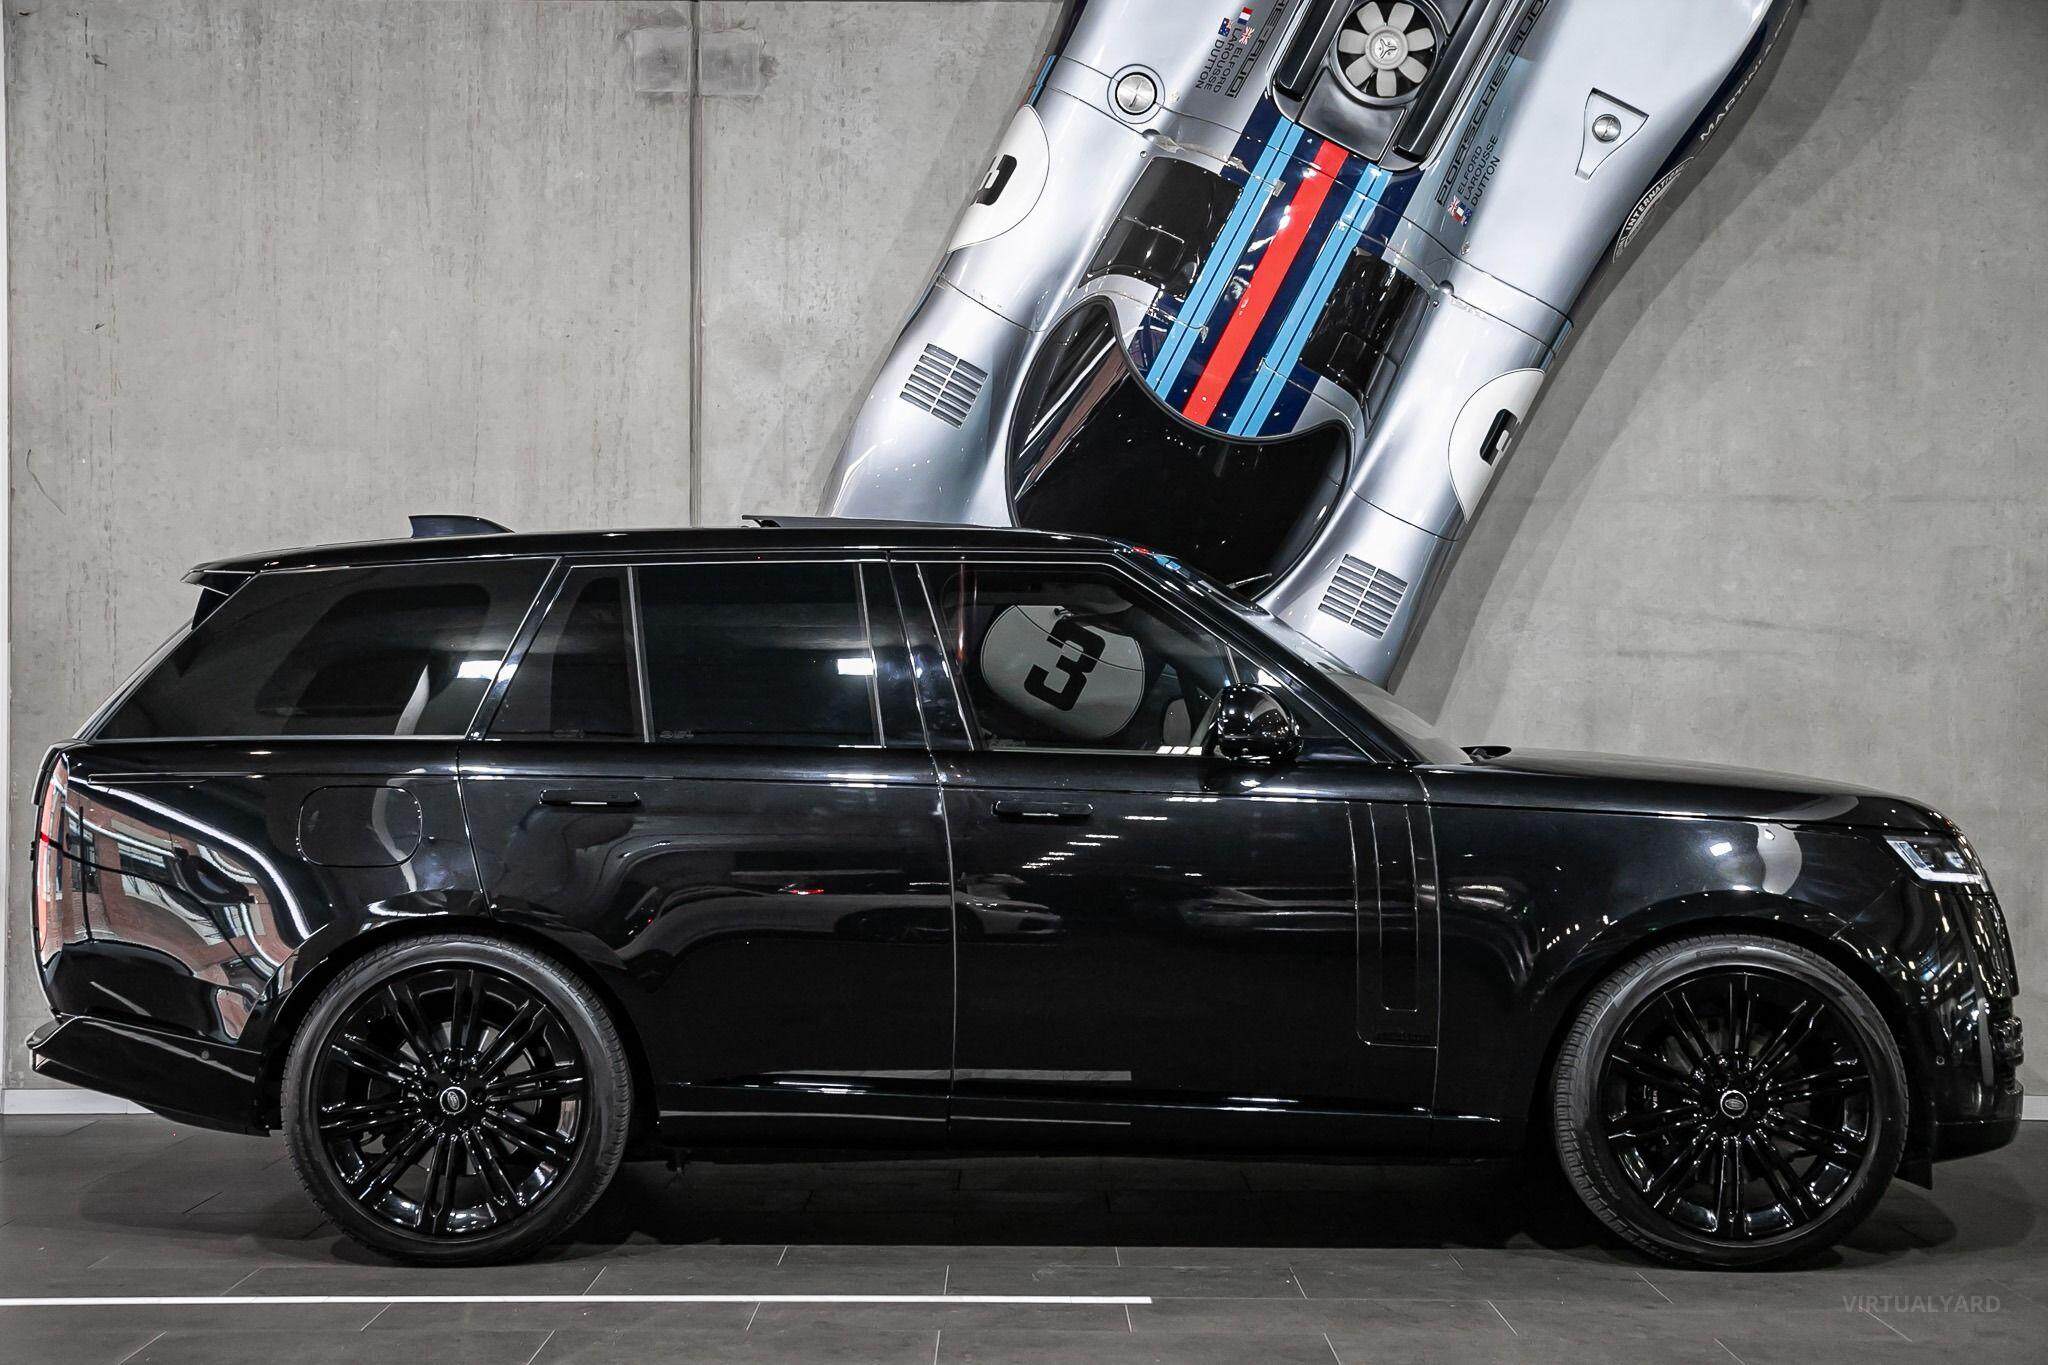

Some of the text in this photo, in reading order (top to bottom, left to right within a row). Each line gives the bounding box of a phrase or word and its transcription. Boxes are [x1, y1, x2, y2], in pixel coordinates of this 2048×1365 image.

[1195, 39, 1225, 89] DUTTON
[1203, 27, 1242, 91] LAROUSSE
[1213, 47, 1243, 93] ELFORD
[1437, 0, 1545, 206] PORSCHE-AUD
[1457, 146, 1483, 195] ELFORD
[1464, 134, 1499, 201] LAROUSSE
[1471, 155, 1501, 206] DUTTON
[1023, 617, 1106, 712] 3
